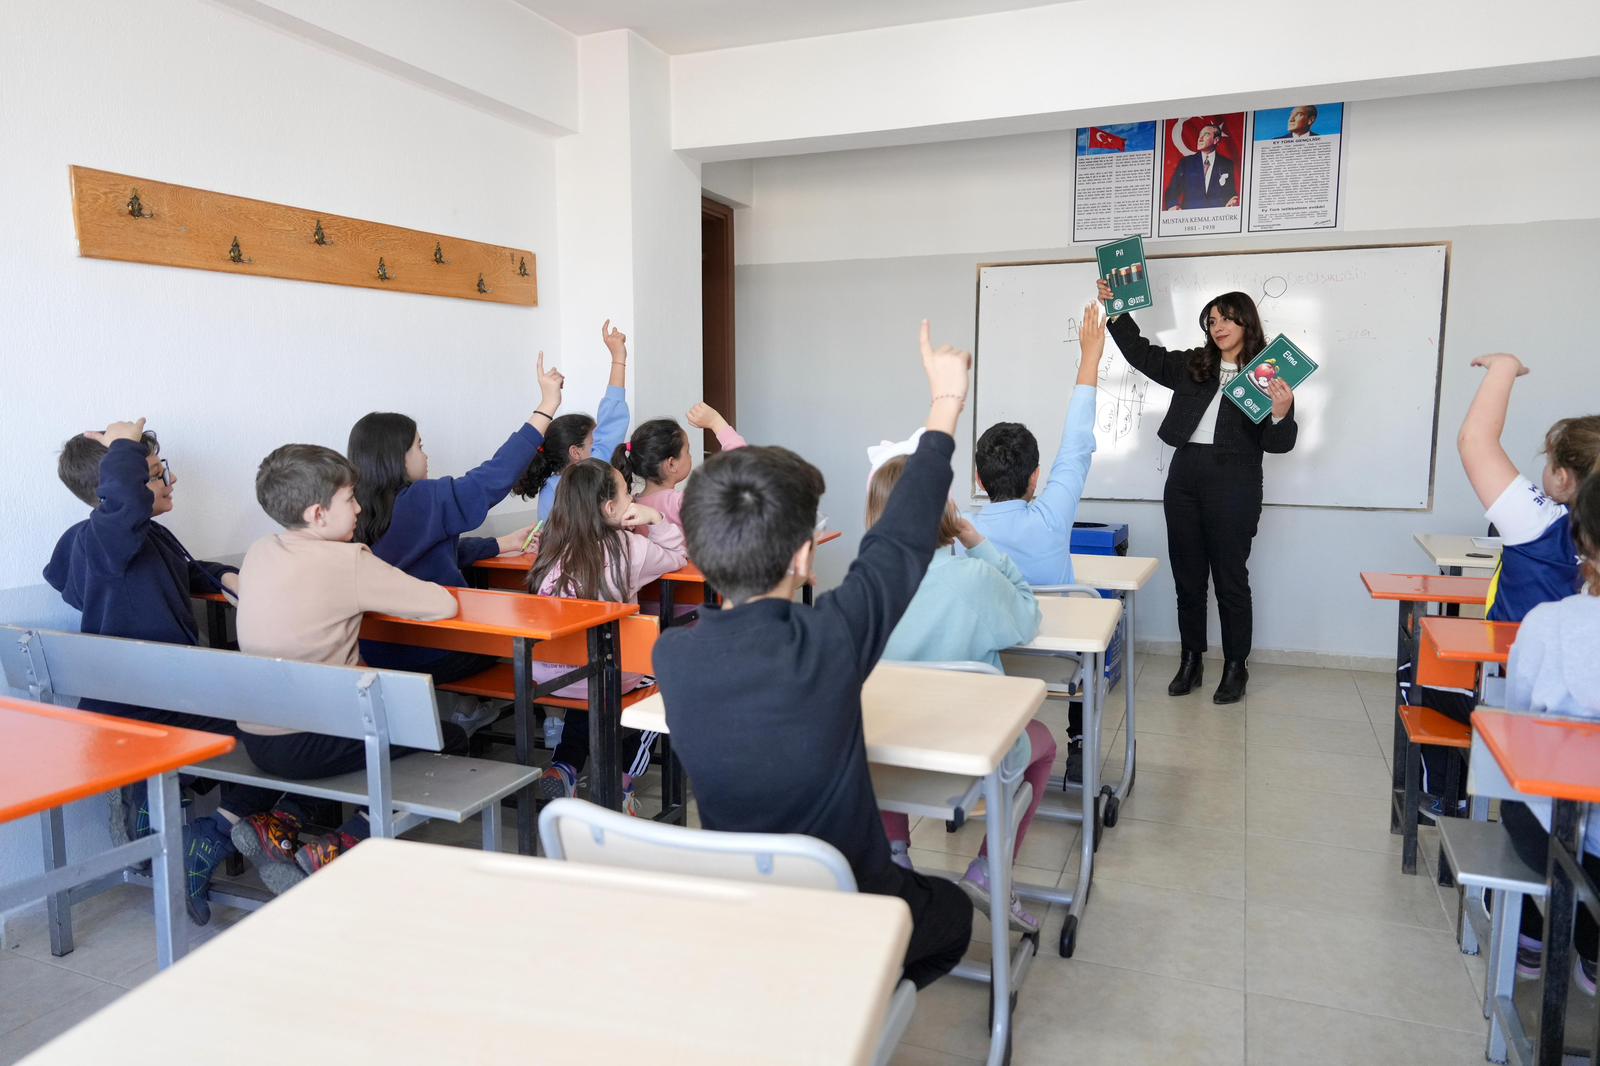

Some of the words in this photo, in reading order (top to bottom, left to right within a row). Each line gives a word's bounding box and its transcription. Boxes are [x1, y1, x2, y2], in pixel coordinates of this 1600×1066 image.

[1161, 217, 1190, 225] MUSTAFA
[1190, 215, 1211, 223] KEMAL
[1211, 214, 1239, 222] ATATÜRK
[1115, 249, 1124, 257] Pil
[1282, 350, 1298, 366] Elma
